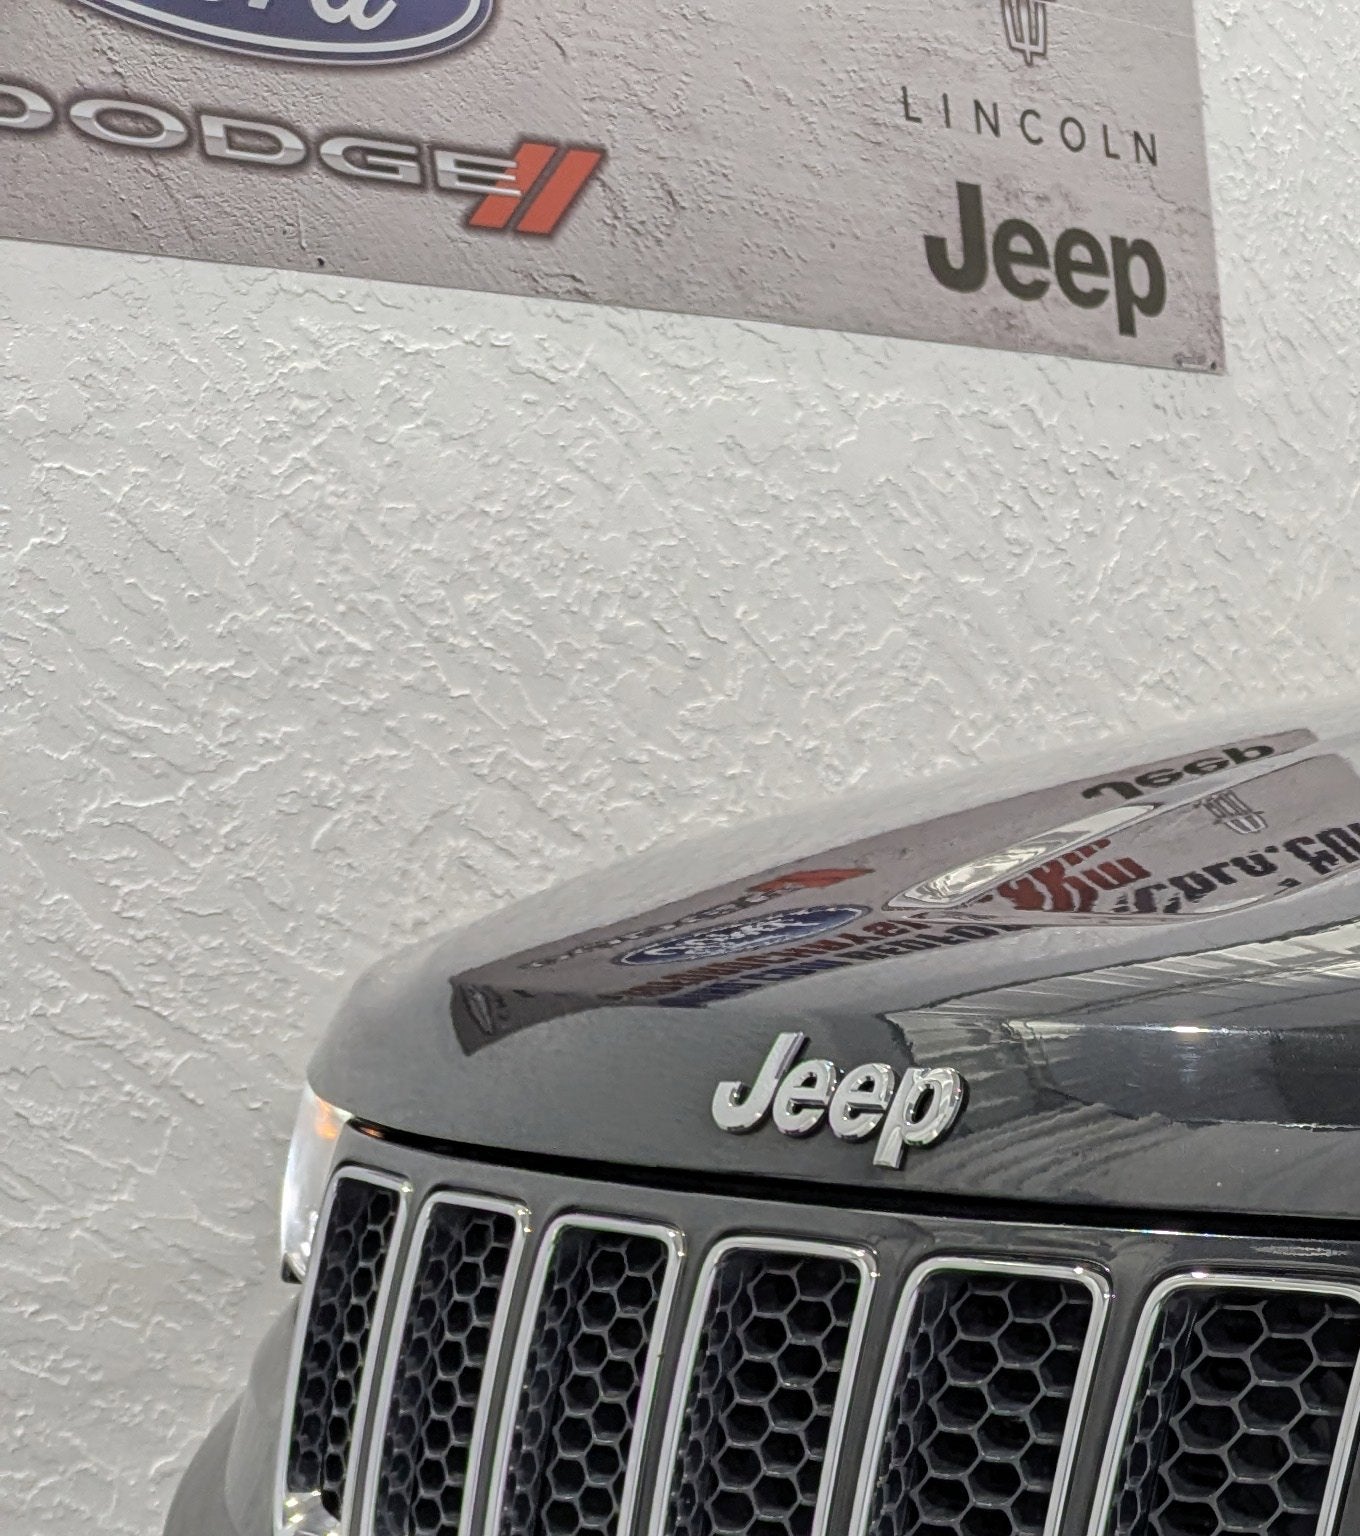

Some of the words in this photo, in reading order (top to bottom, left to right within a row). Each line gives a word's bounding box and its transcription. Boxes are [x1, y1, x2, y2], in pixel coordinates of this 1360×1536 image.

[901, 86, 1158, 166] LINCOLN
[923, 181, 1167, 338] Jeep
[711, 1031, 969, 1169] Jeep
